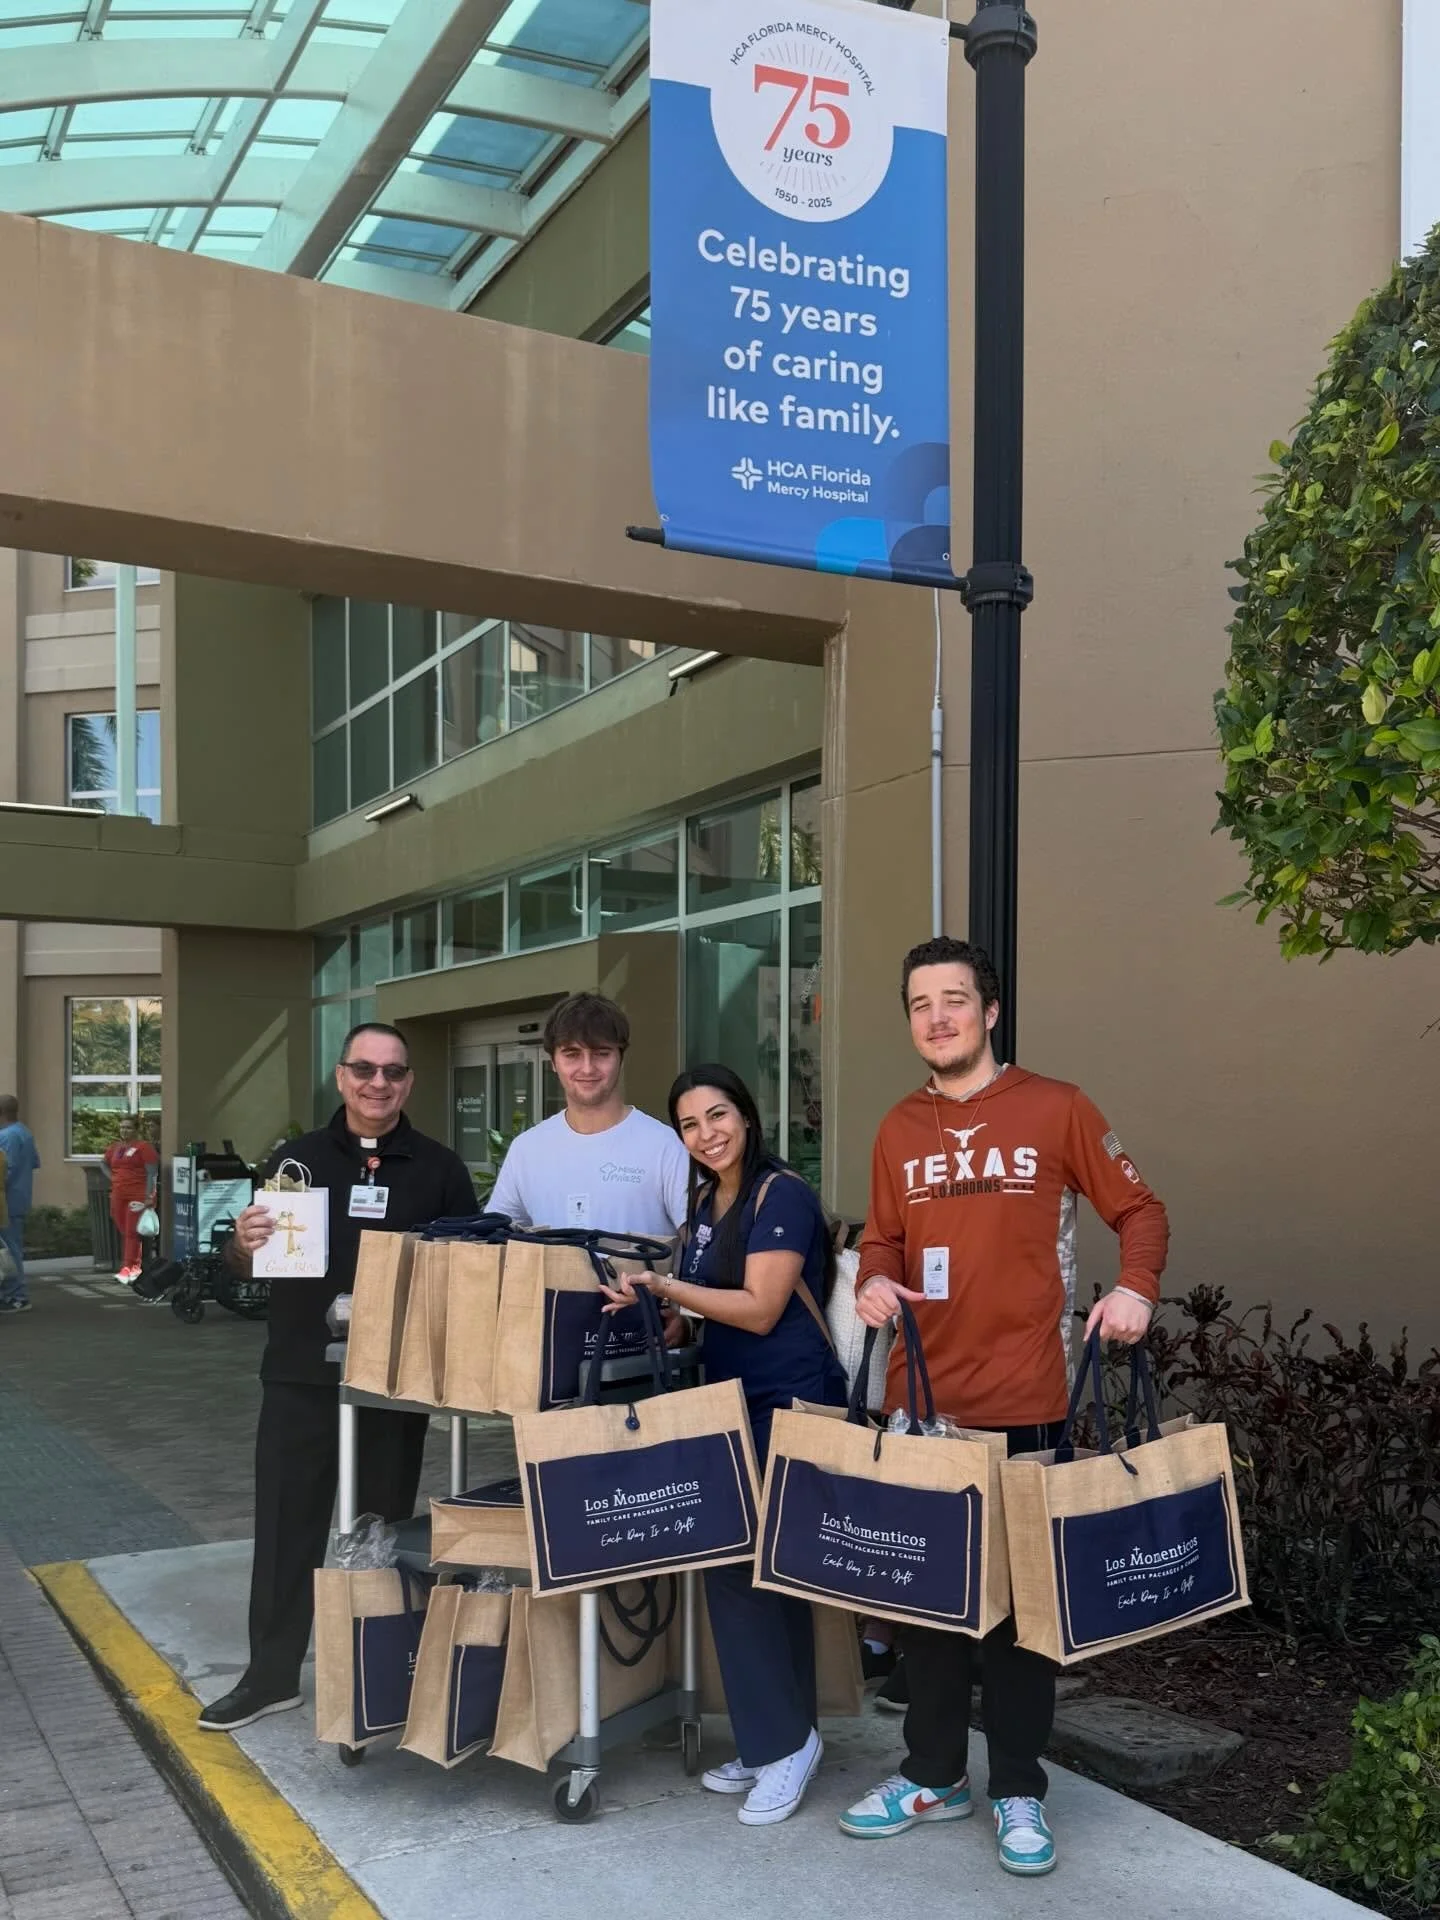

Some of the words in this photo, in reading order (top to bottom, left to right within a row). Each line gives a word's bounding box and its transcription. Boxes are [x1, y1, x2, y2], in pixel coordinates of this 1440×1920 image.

[730, 42, 751, 66] HCA
[747, 22, 793, 46] FLORIDA
[796, 22, 836, 45] MERCY
[836, 41, 876, 96] HOSPITAL
[753, 63, 851, 151] 75
[783, 146, 833, 167] years
[775, 188, 798, 205] 1950
[808, 196, 832, 208] 2025
[698, 228, 909, 298] Celebrating
[730, 286, 771, 322] 75
[781, 303, 877, 337] years
[724, 340, 763, 372] of
[772, 350, 883, 395] caring
[708, 385, 769, 424] like
[780, 394, 900, 445] family.
[767, 460, 808, 480] HCA
[811, 464, 871, 486] Florida
[768, 481, 809, 500] Mercy
[812, 485, 869, 504] Hospital
[903, 1146, 1038, 1189] TEXAS
[176, 1202, 194, 1216] VALT
[584, 1498, 608, 1511] Los
[613, 1480, 699, 1506] Momenticos
[586, 1517, 610, 1525] FAMILY
[613, 1512, 630, 1520] CARE
[633, 1504, 667, 1517] PACKAGES
[677, 1497, 702, 1507] CAUSES
[601, 1531, 622, 1546] Each
[627, 1527, 644, 1541] Day
[650, 1523, 659, 1537] Is
[674, 1516, 696, 1534] Gift
[821, 1512, 840, 1529] Los
[842, 1518, 926, 1547] Momenticos
[818, 1533, 840, 1543] FAMILY
[854, 1544, 889, 1555] PACKAGES
[898, 1552, 925, 1562] CAUSES
[1105, 1558, 1125, 1571] Los
[1129, 1536, 1198, 1566] Momenticos
[822, 1553, 843, 1567] Each
[846, 1559, 861, 1576] Day
[866, 1564, 876, 1576] Is
[891, 1568, 915, 1585] Gift
[1106, 1577, 1126, 1587] FAMILY
[1128, 1573, 1146, 1581] CARE
[1118, 1592, 1137, 1608] Each
[1140, 1589, 1158, 1604] Day
